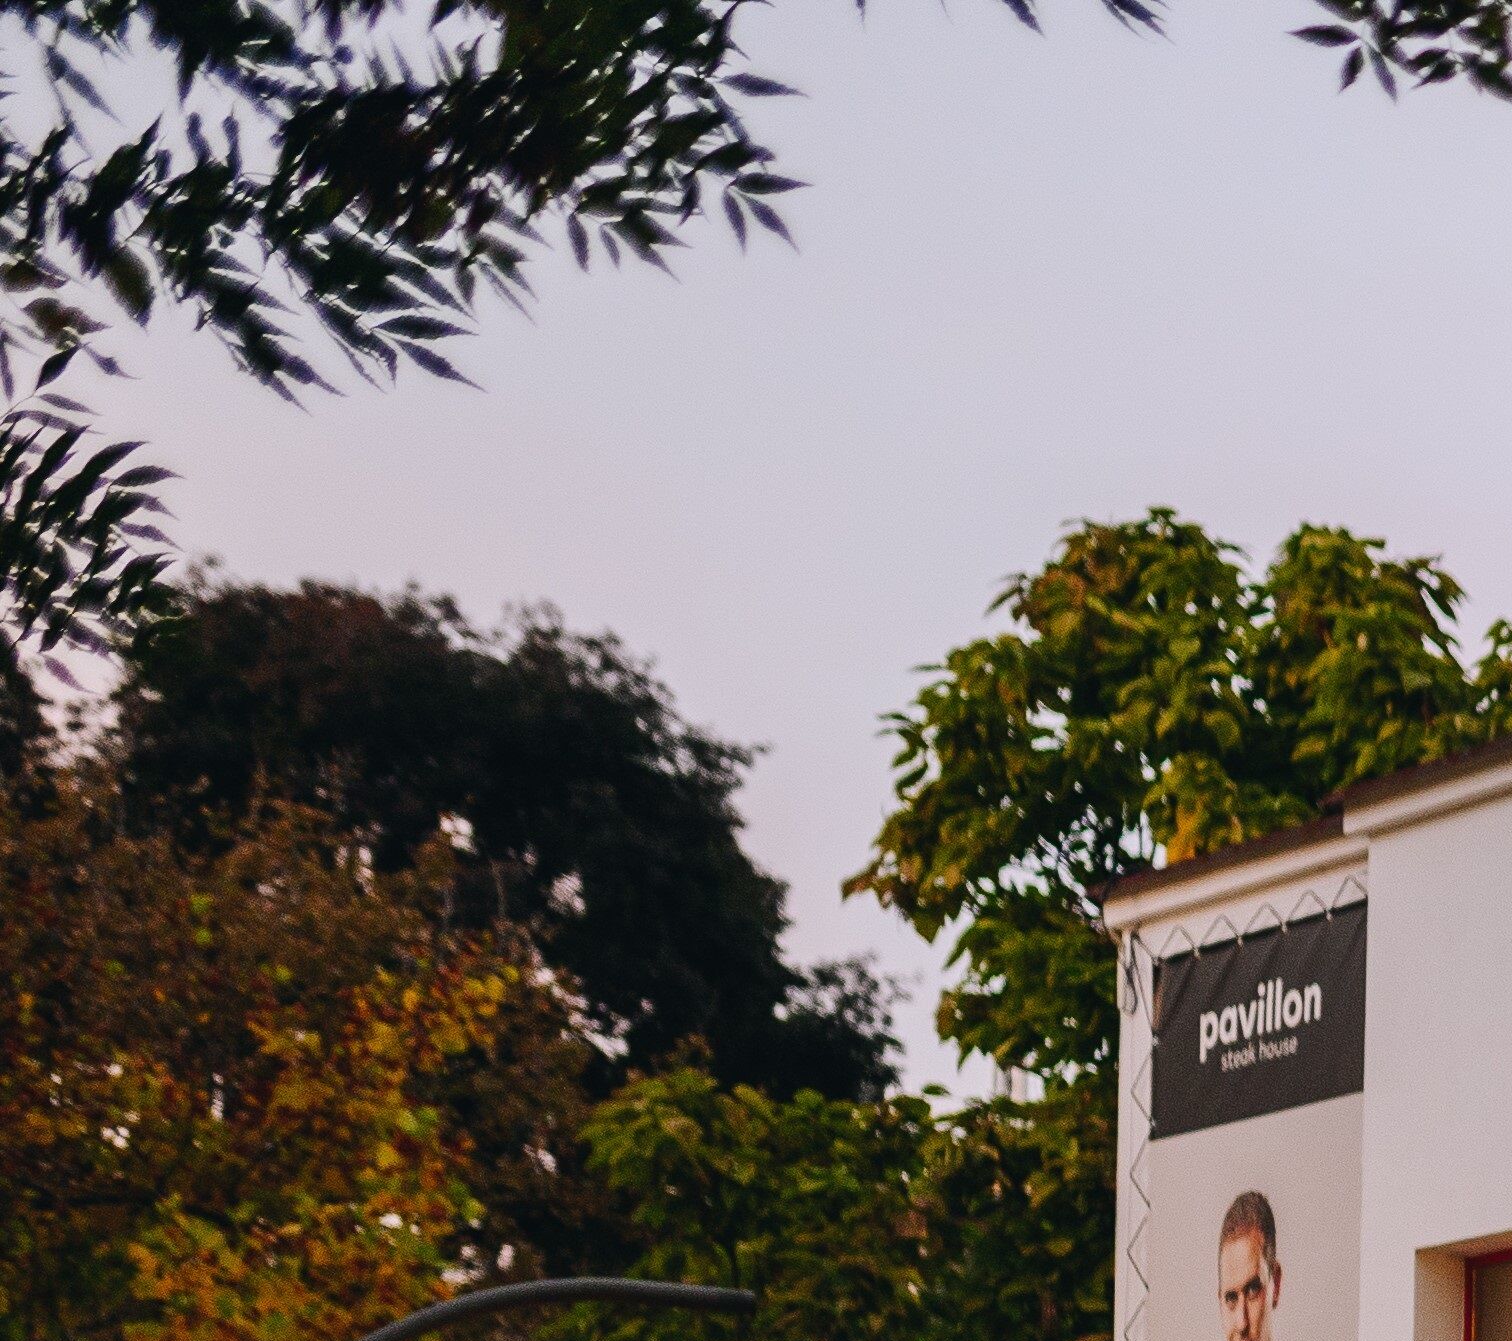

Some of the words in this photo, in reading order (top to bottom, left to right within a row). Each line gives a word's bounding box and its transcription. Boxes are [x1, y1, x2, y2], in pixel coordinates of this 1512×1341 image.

[1199, 976, 1322, 1064] pavillon
[1220, 1043, 1257, 1072] steak
[1259, 1036, 1298, 1062] house
